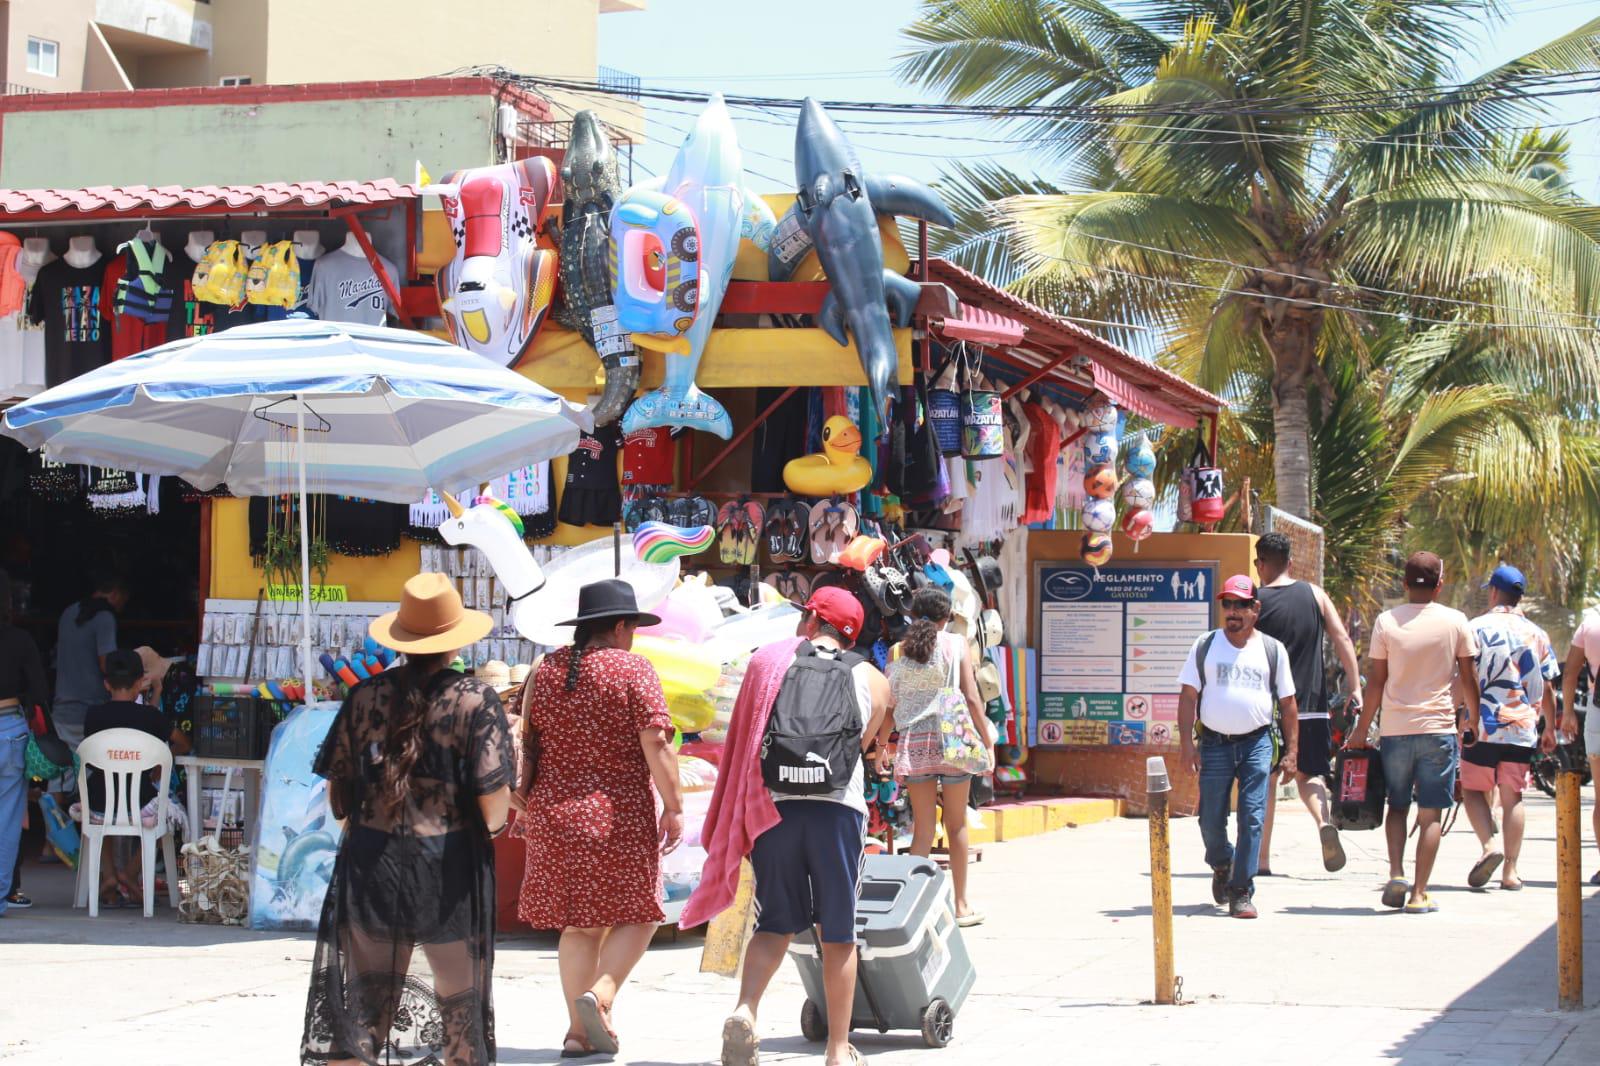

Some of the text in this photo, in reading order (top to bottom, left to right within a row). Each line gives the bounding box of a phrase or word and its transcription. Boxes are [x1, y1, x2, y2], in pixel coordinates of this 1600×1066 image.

[445, 198, 459, 218] 27
[1093, 574, 1164, 583] REGLAMENTO
[1216, 662, 1263, 682] BOSS
[107, 749, 142, 761] TECATE
[779, 765, 825, 784] PUMA
